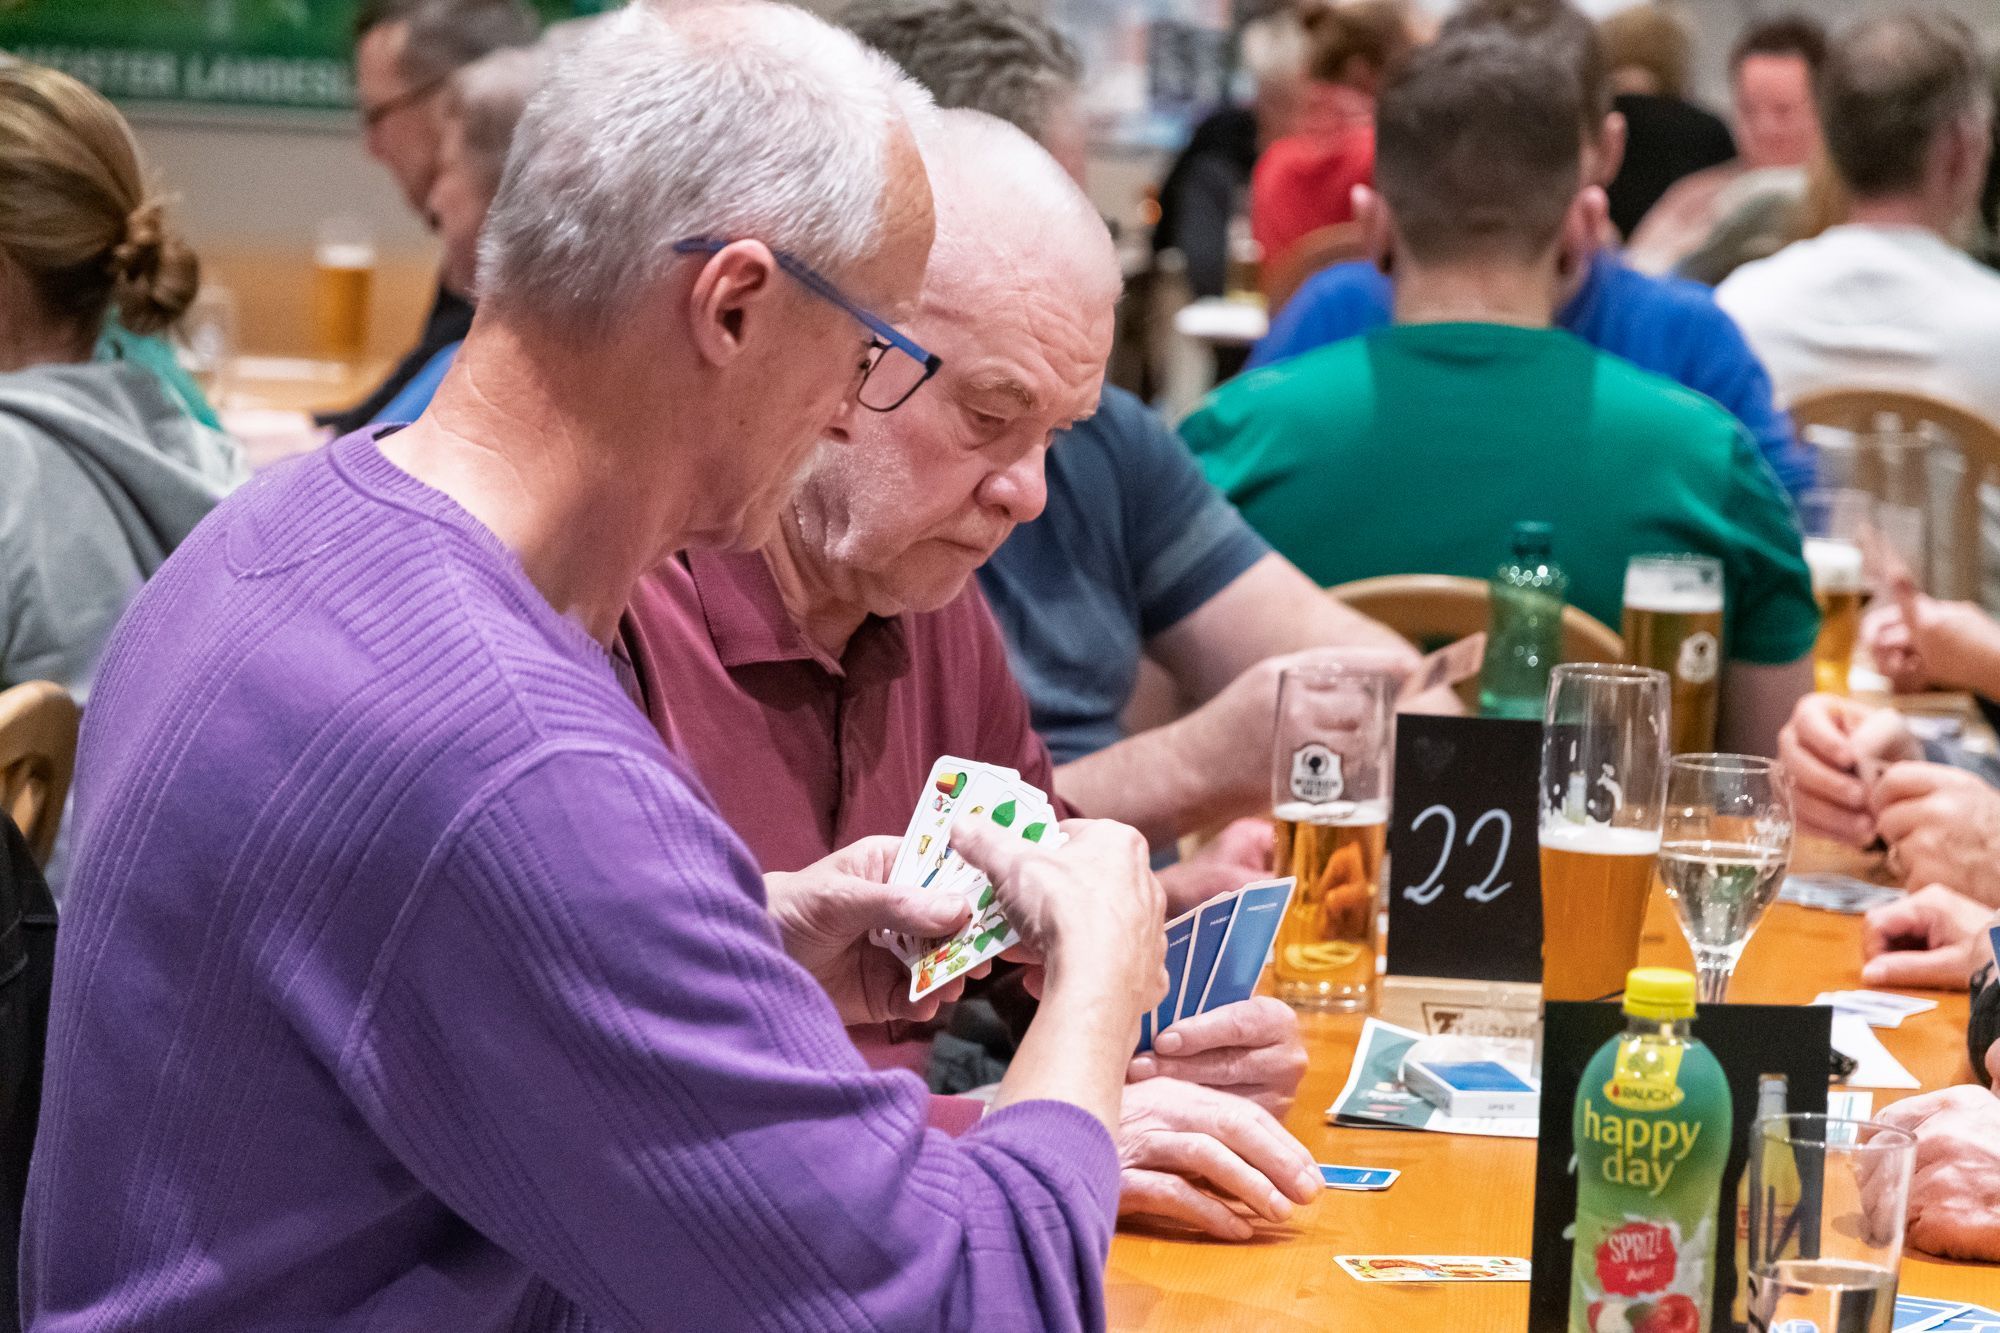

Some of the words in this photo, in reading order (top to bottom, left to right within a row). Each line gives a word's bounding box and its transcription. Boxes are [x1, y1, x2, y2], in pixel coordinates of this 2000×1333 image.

[1403, 804, 1513, 905] 22
[1583, 1099, 1702, 1162] happy
[1602, 1146, 1675, 1197] day
